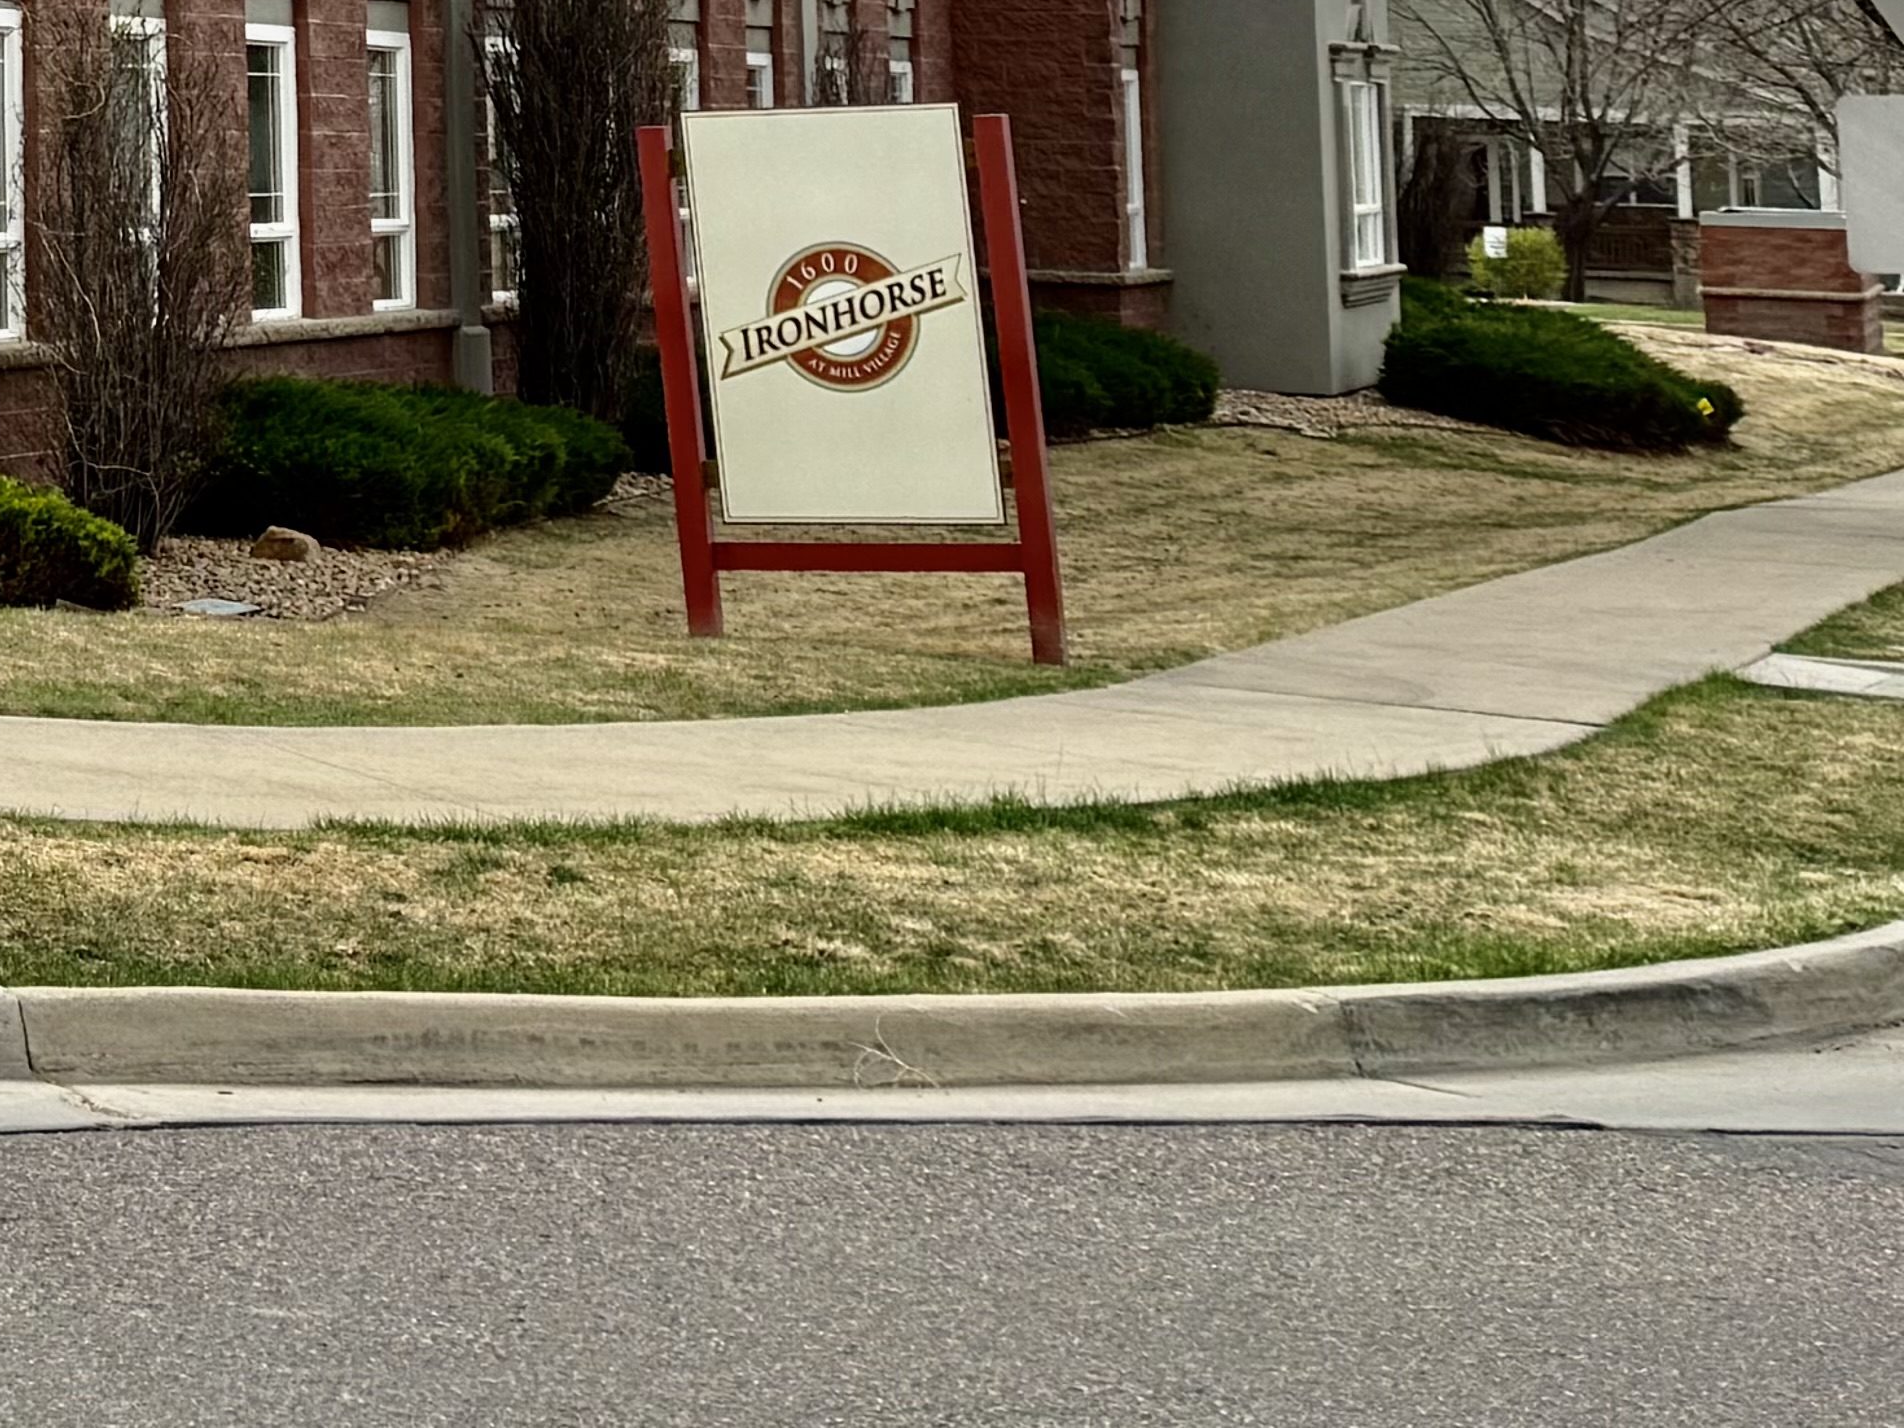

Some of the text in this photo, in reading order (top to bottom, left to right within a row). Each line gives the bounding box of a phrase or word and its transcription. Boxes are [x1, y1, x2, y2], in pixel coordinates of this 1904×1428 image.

[786, 252, 858, 289] 1600
[740, 267, 947, 361] IRONHORSE
[808, 358, 826, 373] AT
[829, 366, 862, 379] MILL
